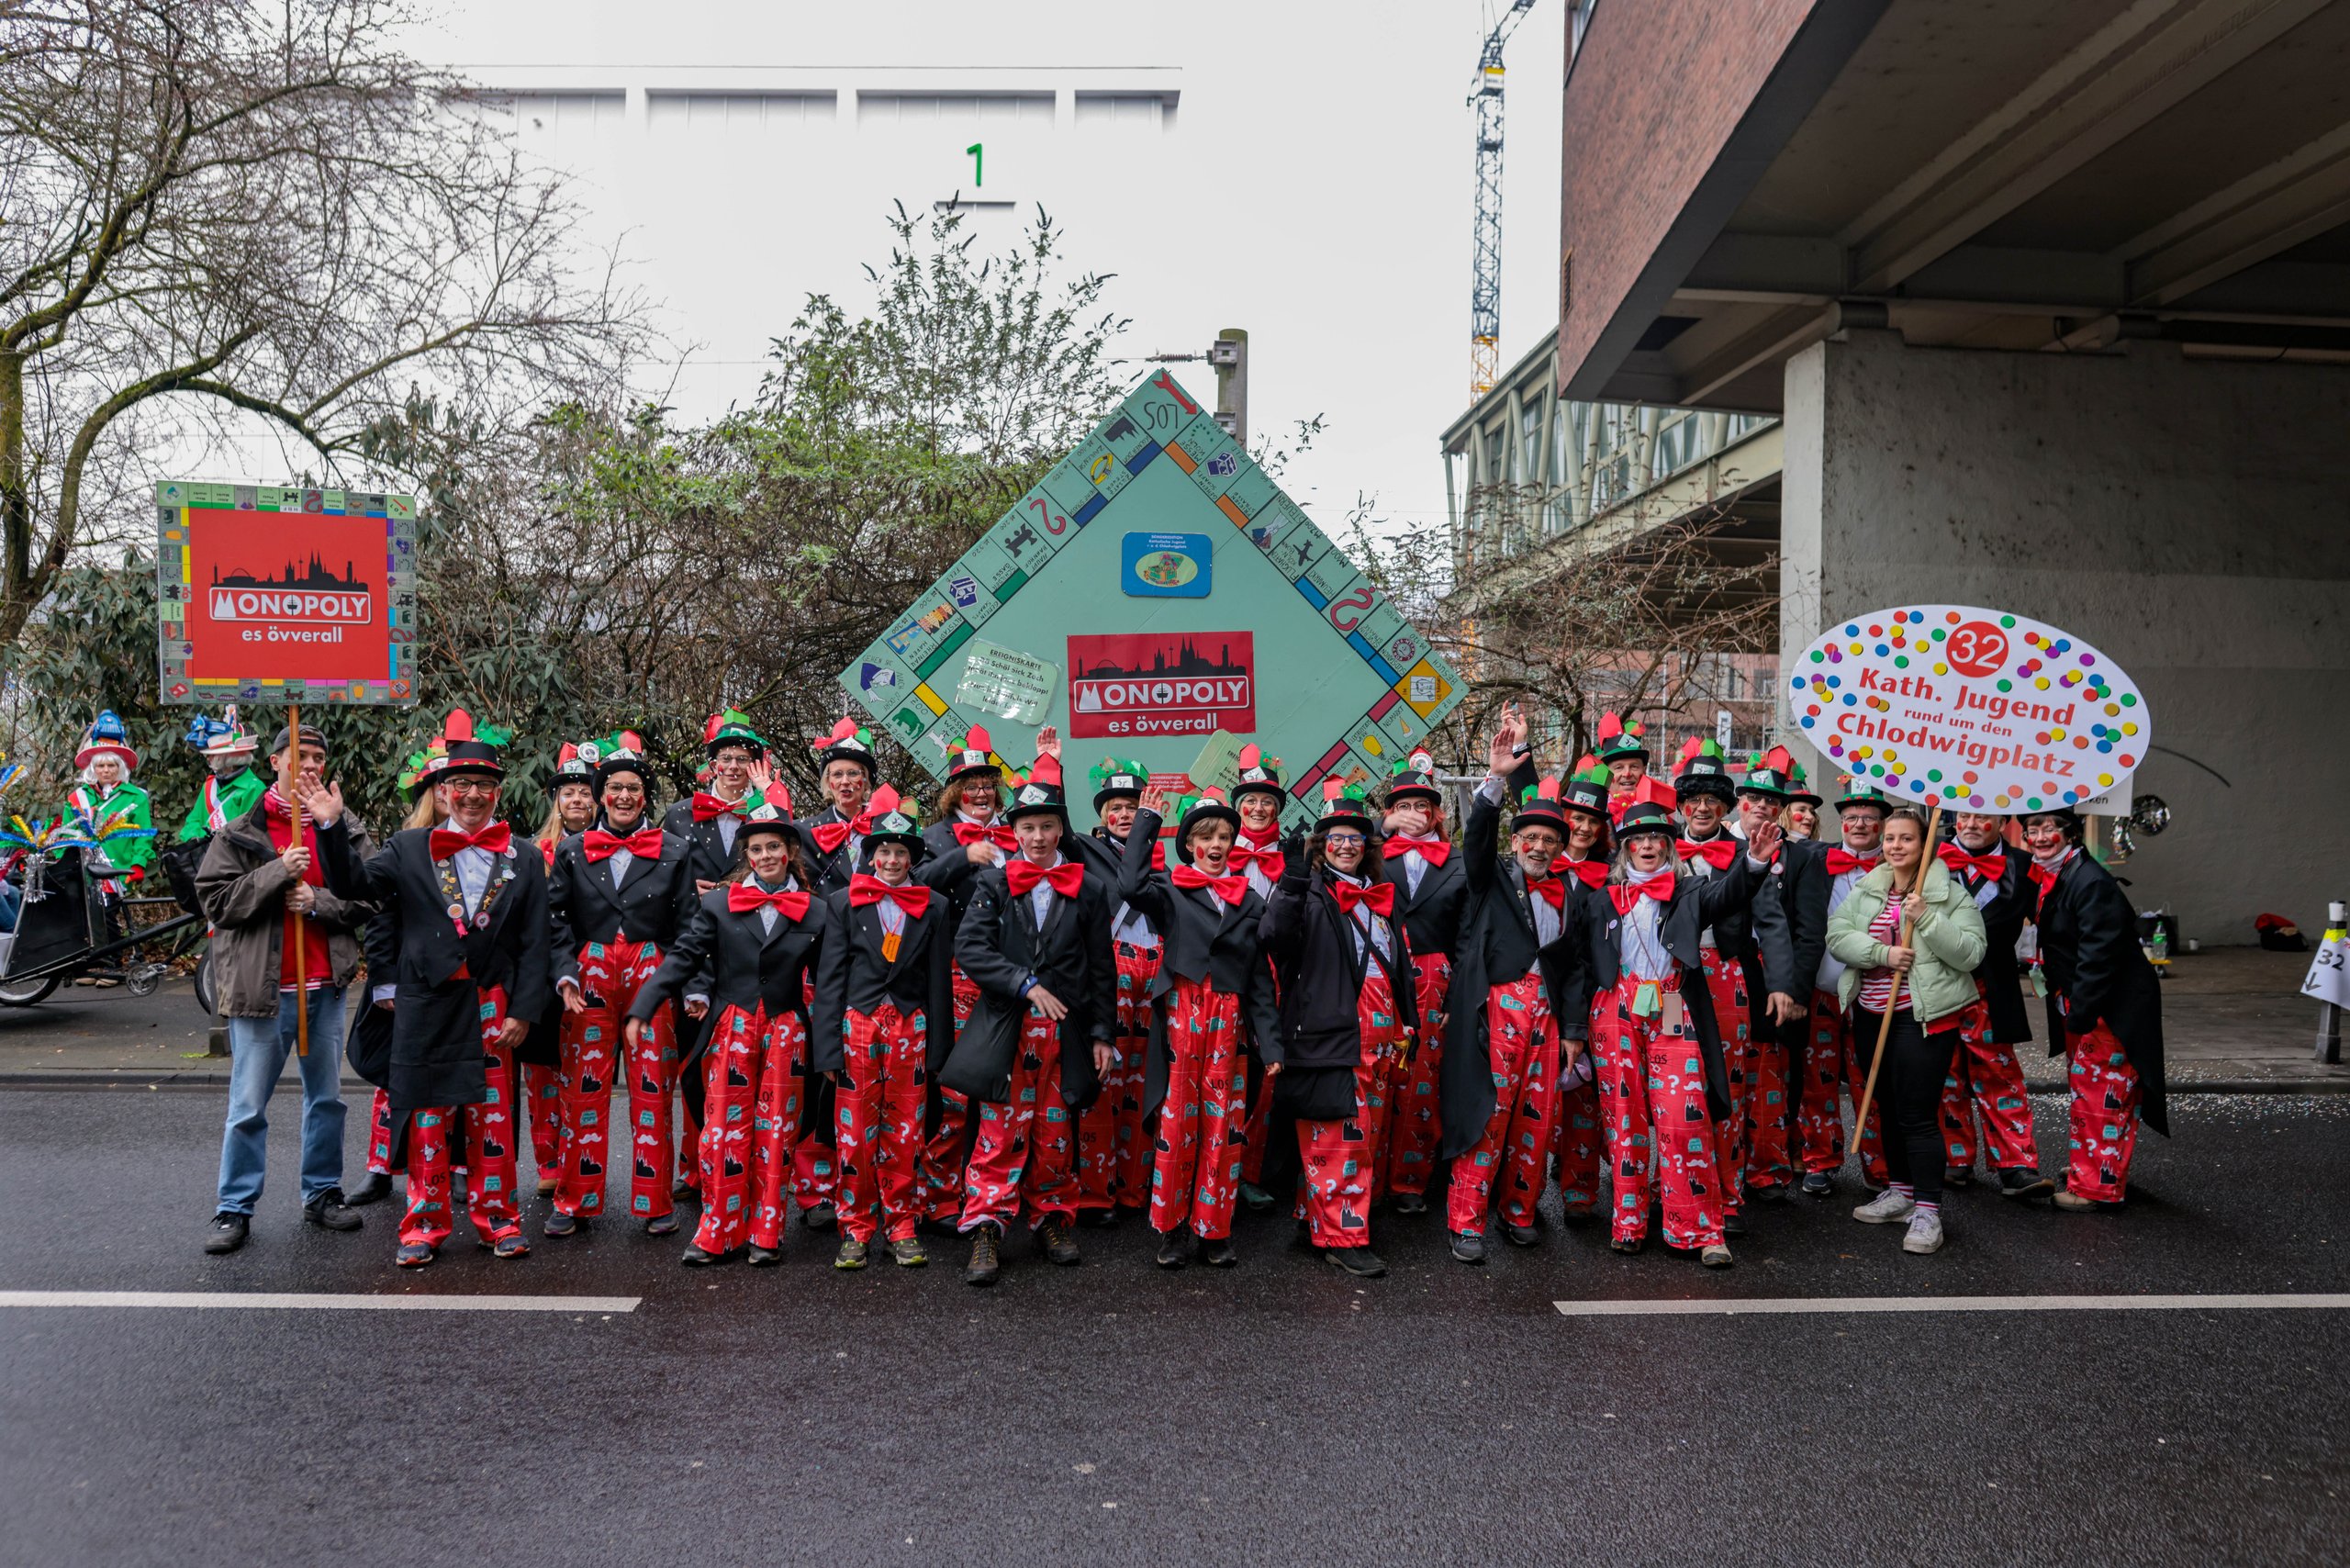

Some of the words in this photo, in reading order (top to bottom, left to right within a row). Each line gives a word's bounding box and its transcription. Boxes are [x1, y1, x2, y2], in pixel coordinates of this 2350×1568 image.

[967, 143, 982, 186] 1
[1144, 401, 1179, 431] LOS
[1178, 439, 1203, 463] MESSE
[1273, 493, 1305, 524] STEUERN
[1306, 568, 1337, 598] HEUMARKT
[214, 590, 367, 618] MONOPOLY
[241, 630, 263, 642] es
[267, 626, 342, 644] övverall
[988, 649, 1043, 670] EREIGNISKARTE
[1951, 629, 2006, 670] 32
[1432, 658, 1459, 685] BESUCH
[909, 696, 929, 716] ZOO
[1078, 681, 1245, 710] MONOPOLY
[1859, 667, 1942, 702] Kath.
[1953, 685, 2076, 726] Jugend
[945, 711, 967, 733] WASSE
[1108, 721, 1130, 733] es
[1136, 712, 1217, 733] övverall
[1427, 708, 1443, 723] NUR
[1904, 708, 1943, 724] rund
[1949, 717, 1975, 730] um
[1981, 721, 2013, 737] den
[1837, 712, 2076, 778] Chlodwigplatz
[2318, 948, 2344, 972] 32
